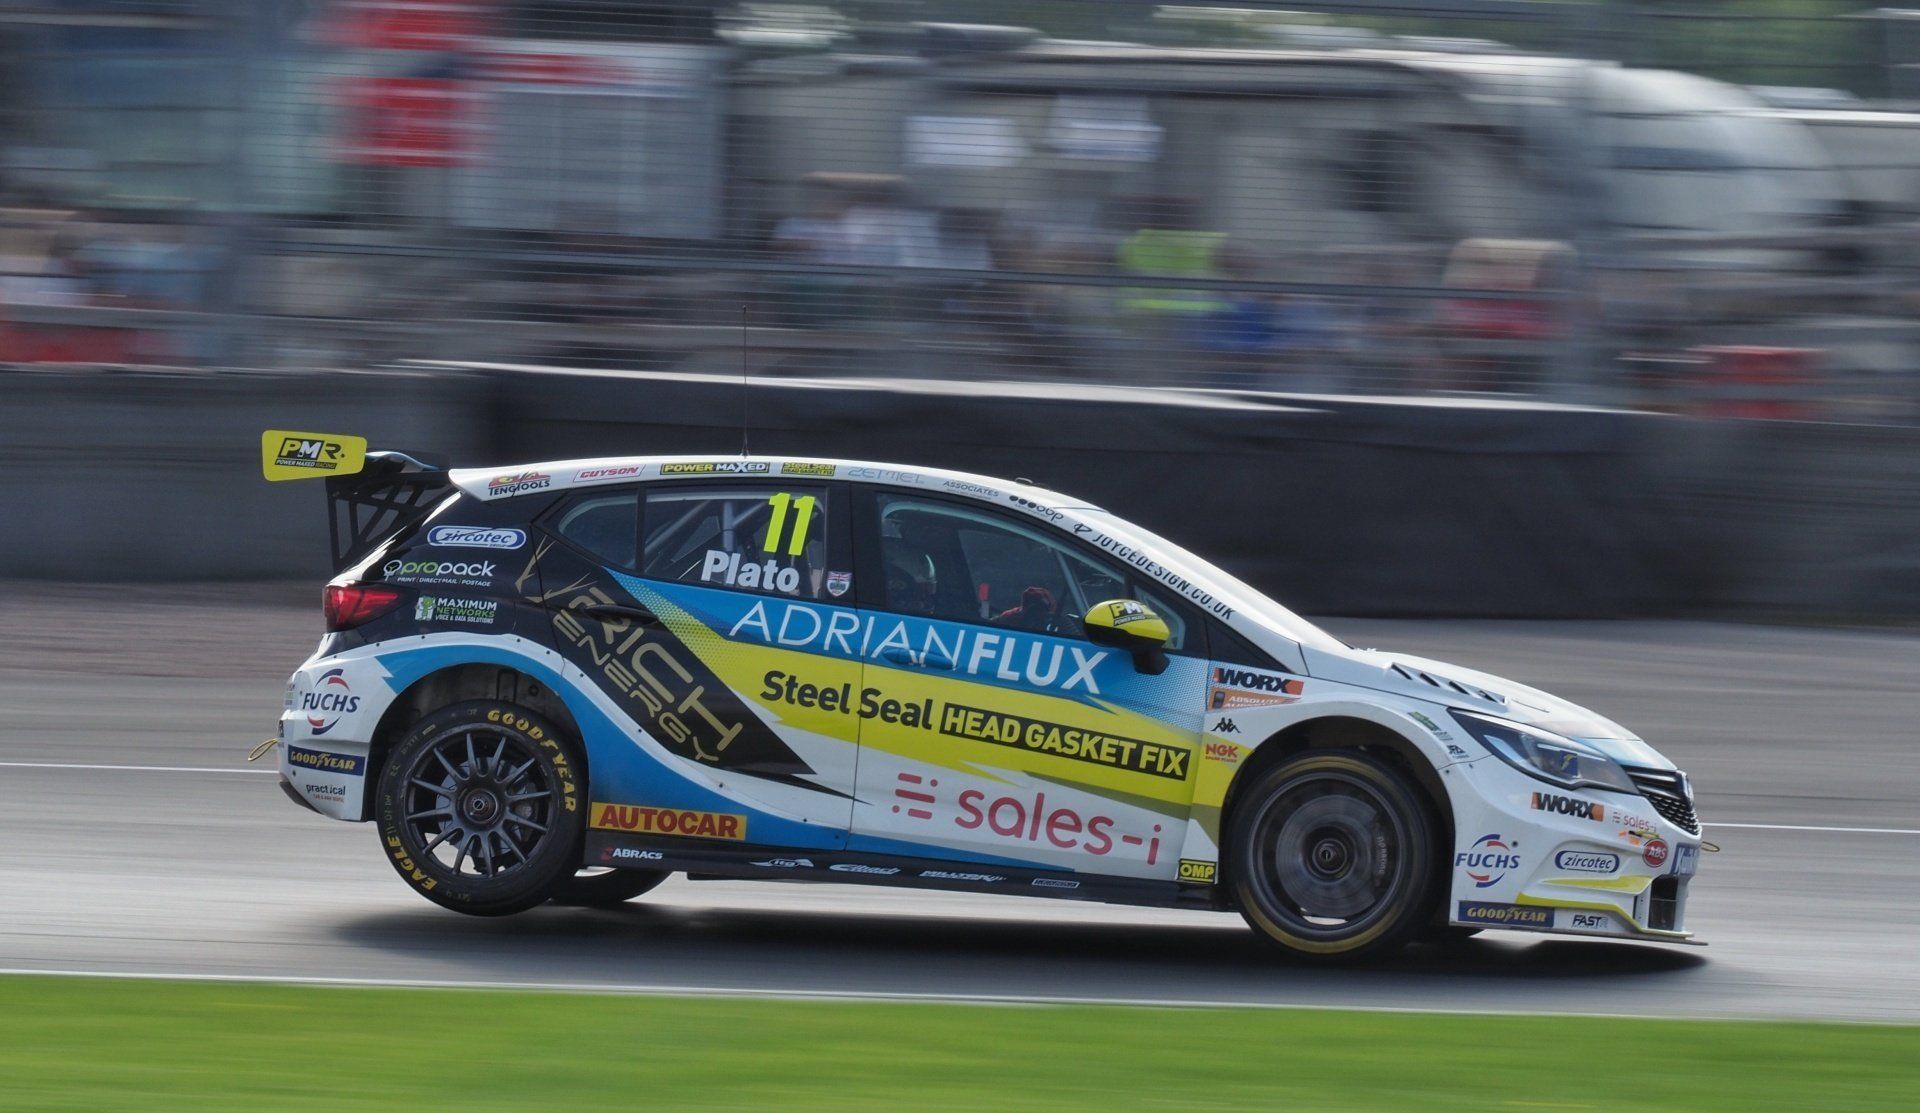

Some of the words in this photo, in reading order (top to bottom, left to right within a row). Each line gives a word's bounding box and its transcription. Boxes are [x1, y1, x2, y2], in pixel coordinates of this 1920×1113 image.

[580, 467, 639, 479] GUYSON
[663, 463, 714, 473] POWER
[715, 461, 766, 474] MAXED
[943, 480, 1000, 498] ASSOCIATES
[763, 492, 815, 556] 11
[440, 530, 512, 544] zircotec
[400, 560, 497, 577] propack
[700, 549, 800, 593] Plato
[1092, 533, 1237, 621] JOYCEDESIGN.CO.UK
[436, 606, 496, 618] NETWORKS
[437, 597, 498, 611] MAXIMUM
[553, 609, 719, 762] ENERGY
[1216, 667, 1292, 694] WORX
[302, 692, 361, 713] FUCHS
[759, 669, 851, 715] Steel
[856, 687, 933, 730] Seal
[944, 706, 1020, 744] HEAD
[1026, 723, 1136, 766] GASKET
[1140, 744, 1186, 777] FIX
[1206, 743, 1239, 758] NGK
[291, 752, 356, 771] GOODYEAR
[487, 708, 577, 812] GOODYEAR
[306, 783, 346, 796] practical
[1536, 792, 1595, 820] WORX
[600, 804, 739, 838] AUTOCAR
[955, 788, 1163, 865] sales-i
[612, 847, 664, 860] ABRACS
[1455, 852, 1521, 869] FUCHS
[1563, 855, 1613, 870] zircotec
[387, 834, 440, 892] EAGLE
[1180, 863, 1214, 878] OMP
[1467, 905, 1547, 923] GOODYEAR
